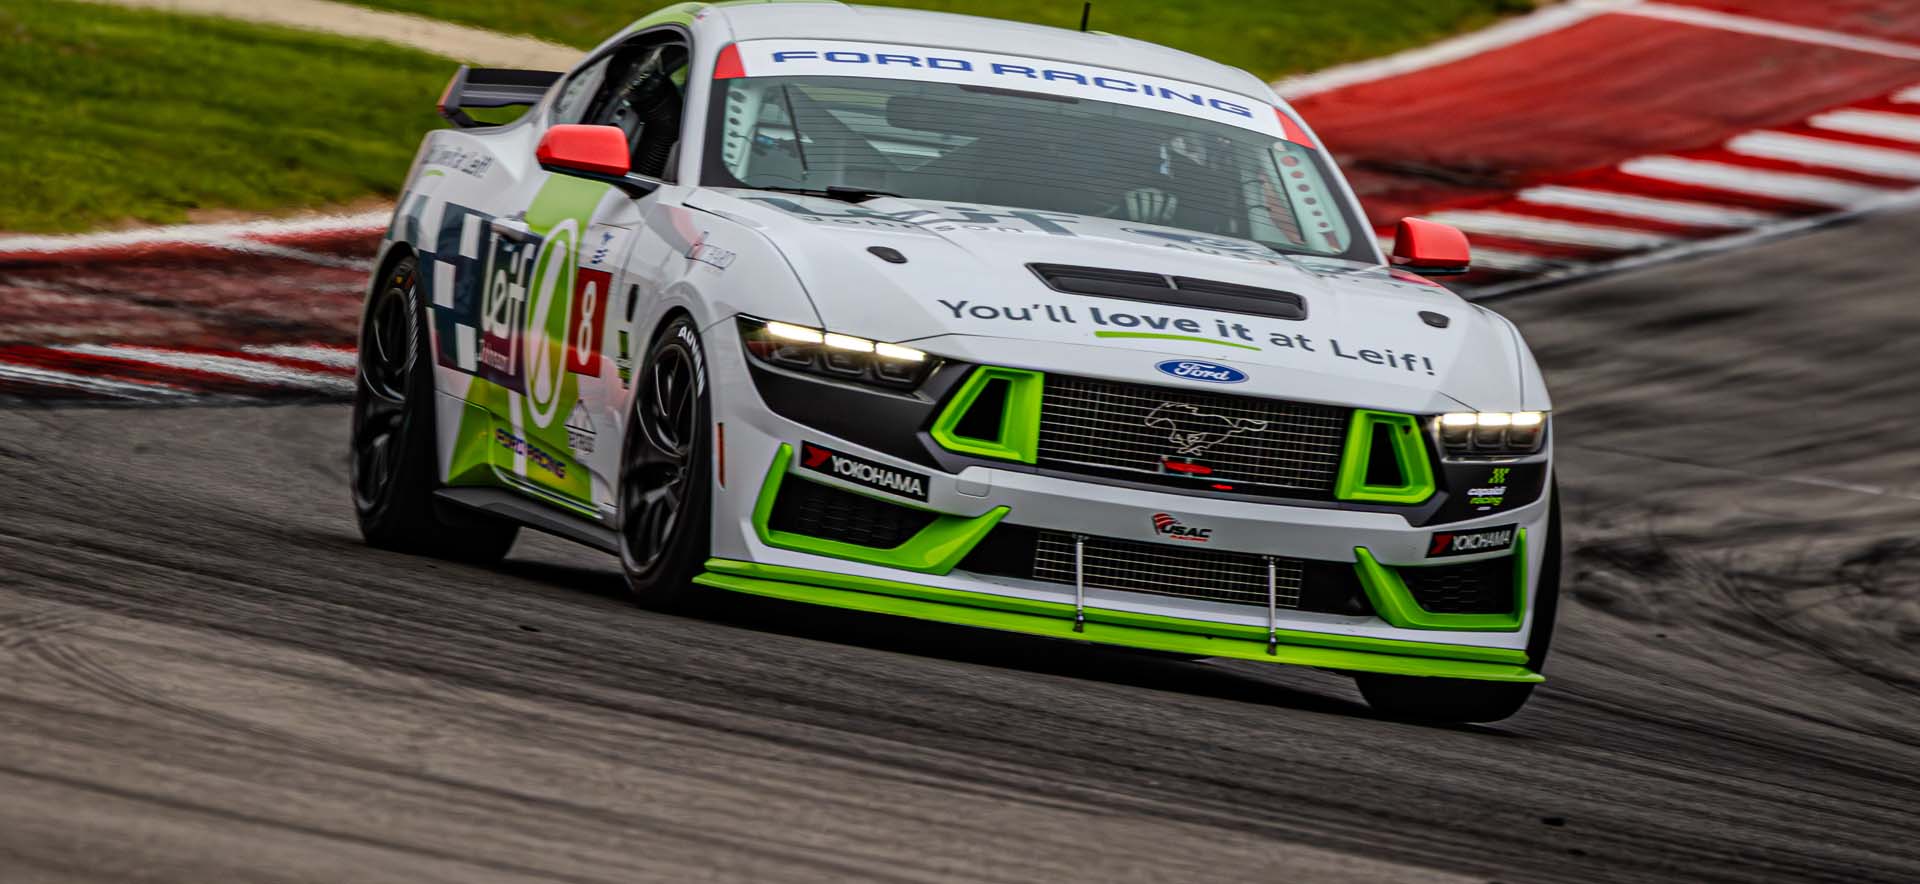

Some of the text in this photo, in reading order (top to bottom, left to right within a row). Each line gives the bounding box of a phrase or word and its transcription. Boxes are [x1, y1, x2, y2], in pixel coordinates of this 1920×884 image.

[772, 51, 1255, 119] FORD RACING
[576, 280, 598, 366] 8
[937, 299, 1436, 376] You'll love it at Leif!
[1173, 362, 1231, 380] Ford
[831, 455, 923, 496] YOKOHAMA
[1160, 525, 1213, 538] USAC
